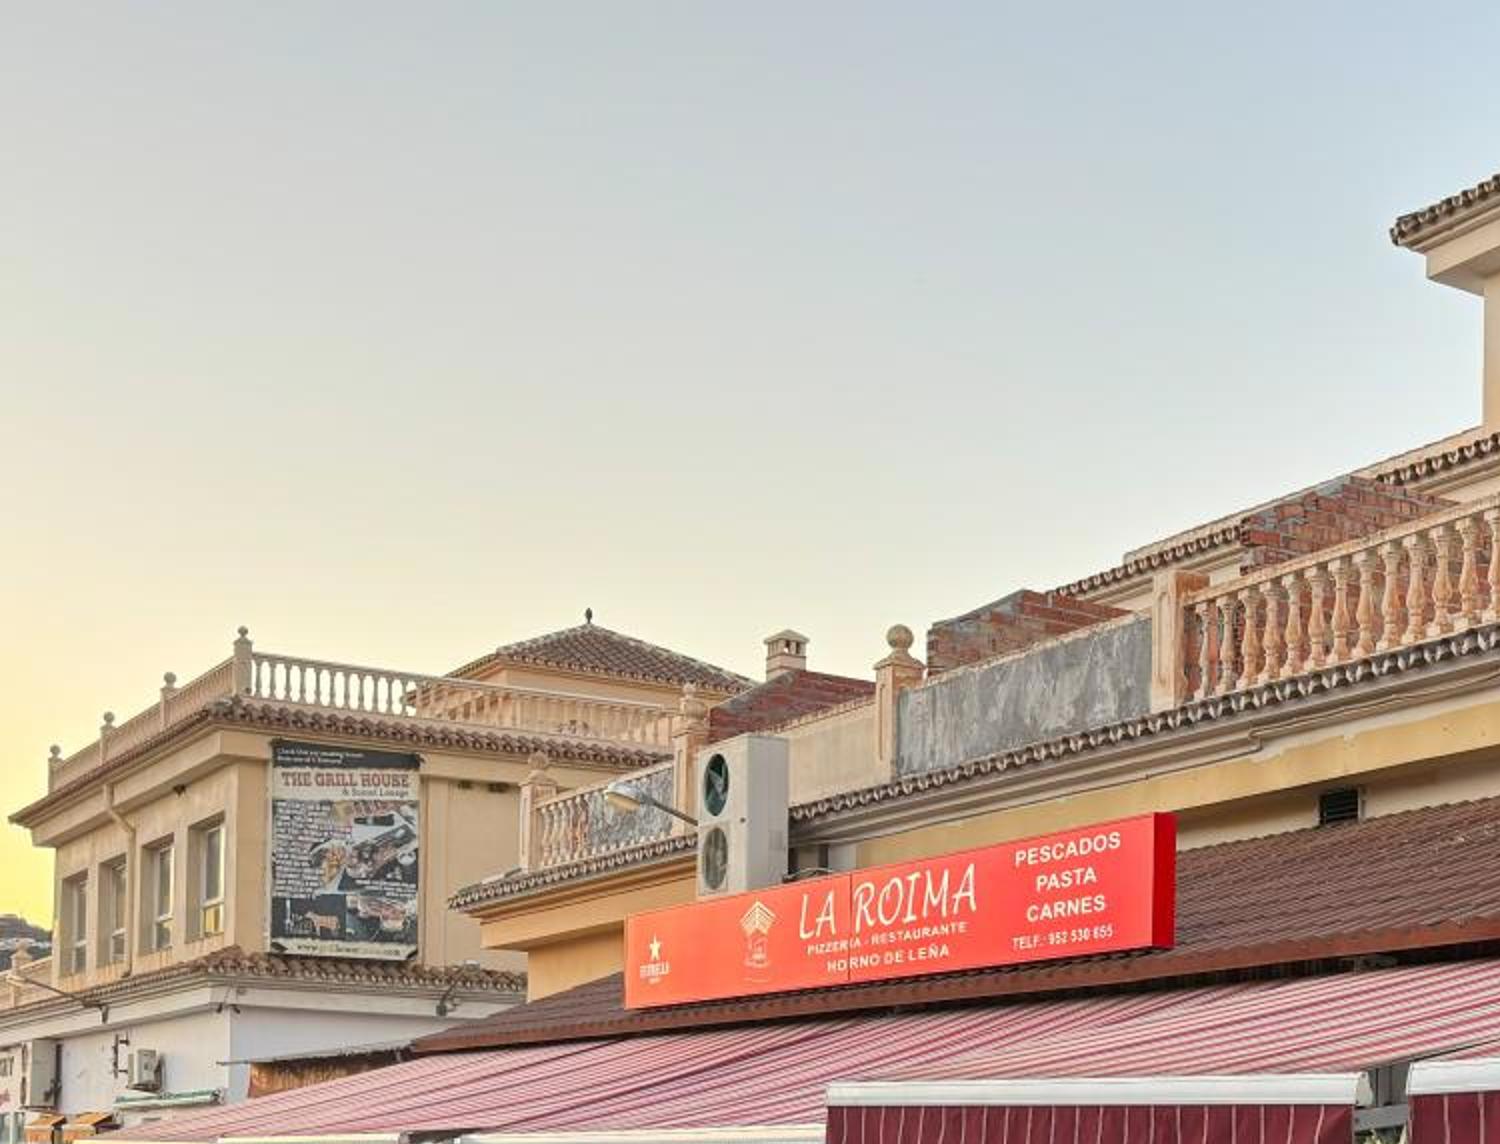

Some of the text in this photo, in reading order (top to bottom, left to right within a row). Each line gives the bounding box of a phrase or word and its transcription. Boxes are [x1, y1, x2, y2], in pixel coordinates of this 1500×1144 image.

[281, 771, 410, 788] THE GRILL HOUSE
[1014, 831, 1121, 868] PESCADOS
[1036, 867, 1097, 892] PASTA
[799, 863, 977, 939] LA ROIMA
[1026, 895, 1105, 922] CARNES
[807, 937, 861, 956] PIZZERIA
[871, 921, 968, 946] RESTAURANTE
[826, 942, 949, 972] HORNO DE LEÑA
